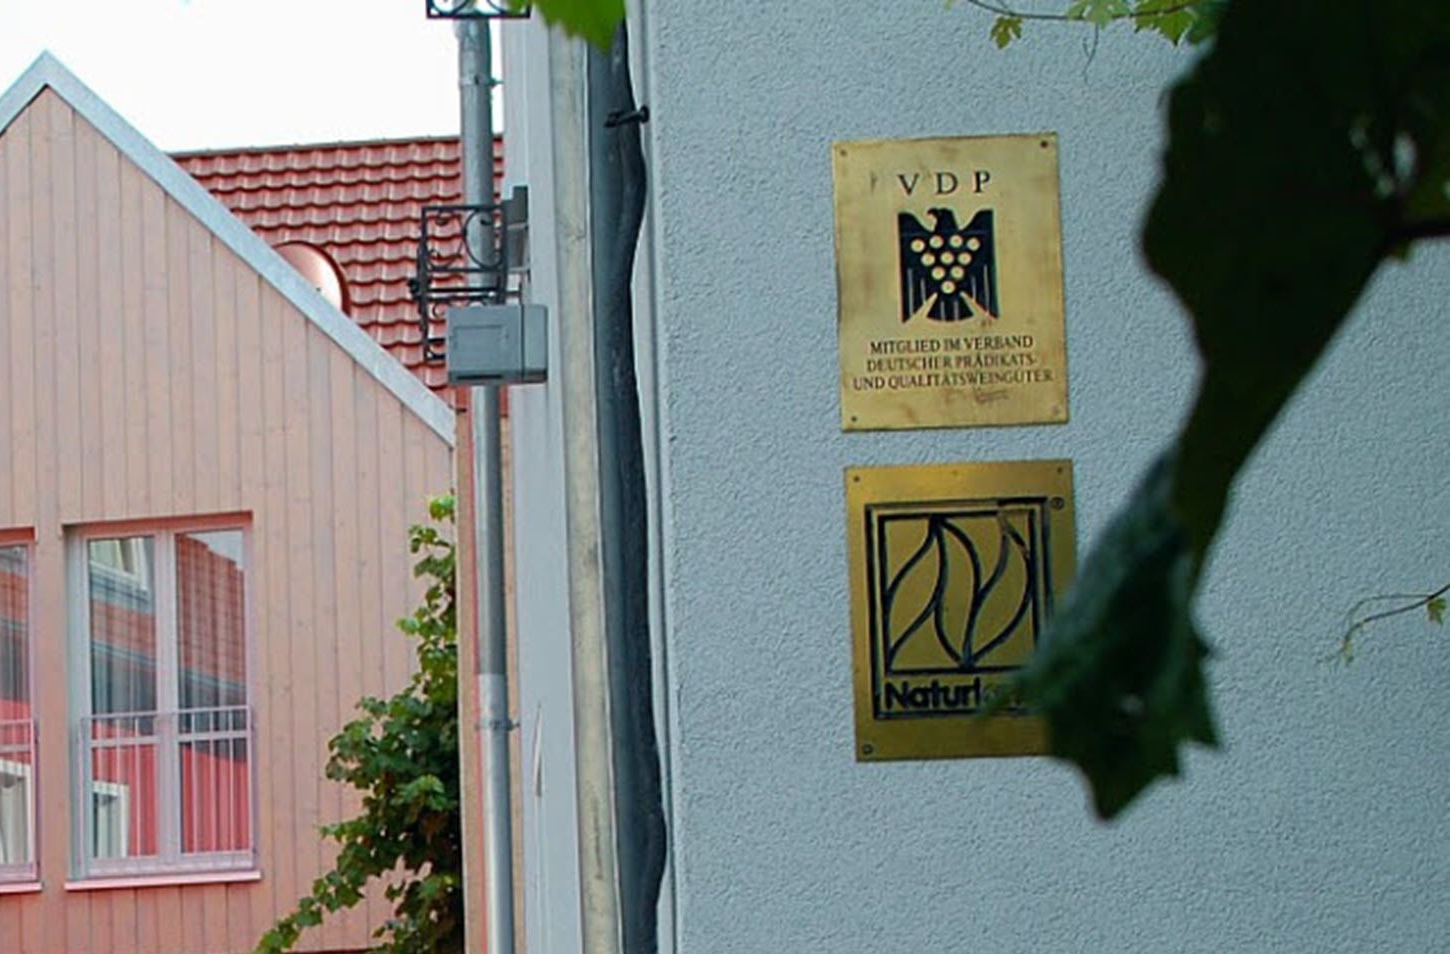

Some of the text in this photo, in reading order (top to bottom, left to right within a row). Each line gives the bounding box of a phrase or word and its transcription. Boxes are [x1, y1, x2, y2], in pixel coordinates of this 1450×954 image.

[898, 170, 991, 195] VDP
[870, 335, 1034, 354] MITGLIED IM VERBAND
[867, 356, 952, 372] DEUTSCHER
[853, 376, 886, 391] UND
[884, 676, 1016, 710] Naturl
